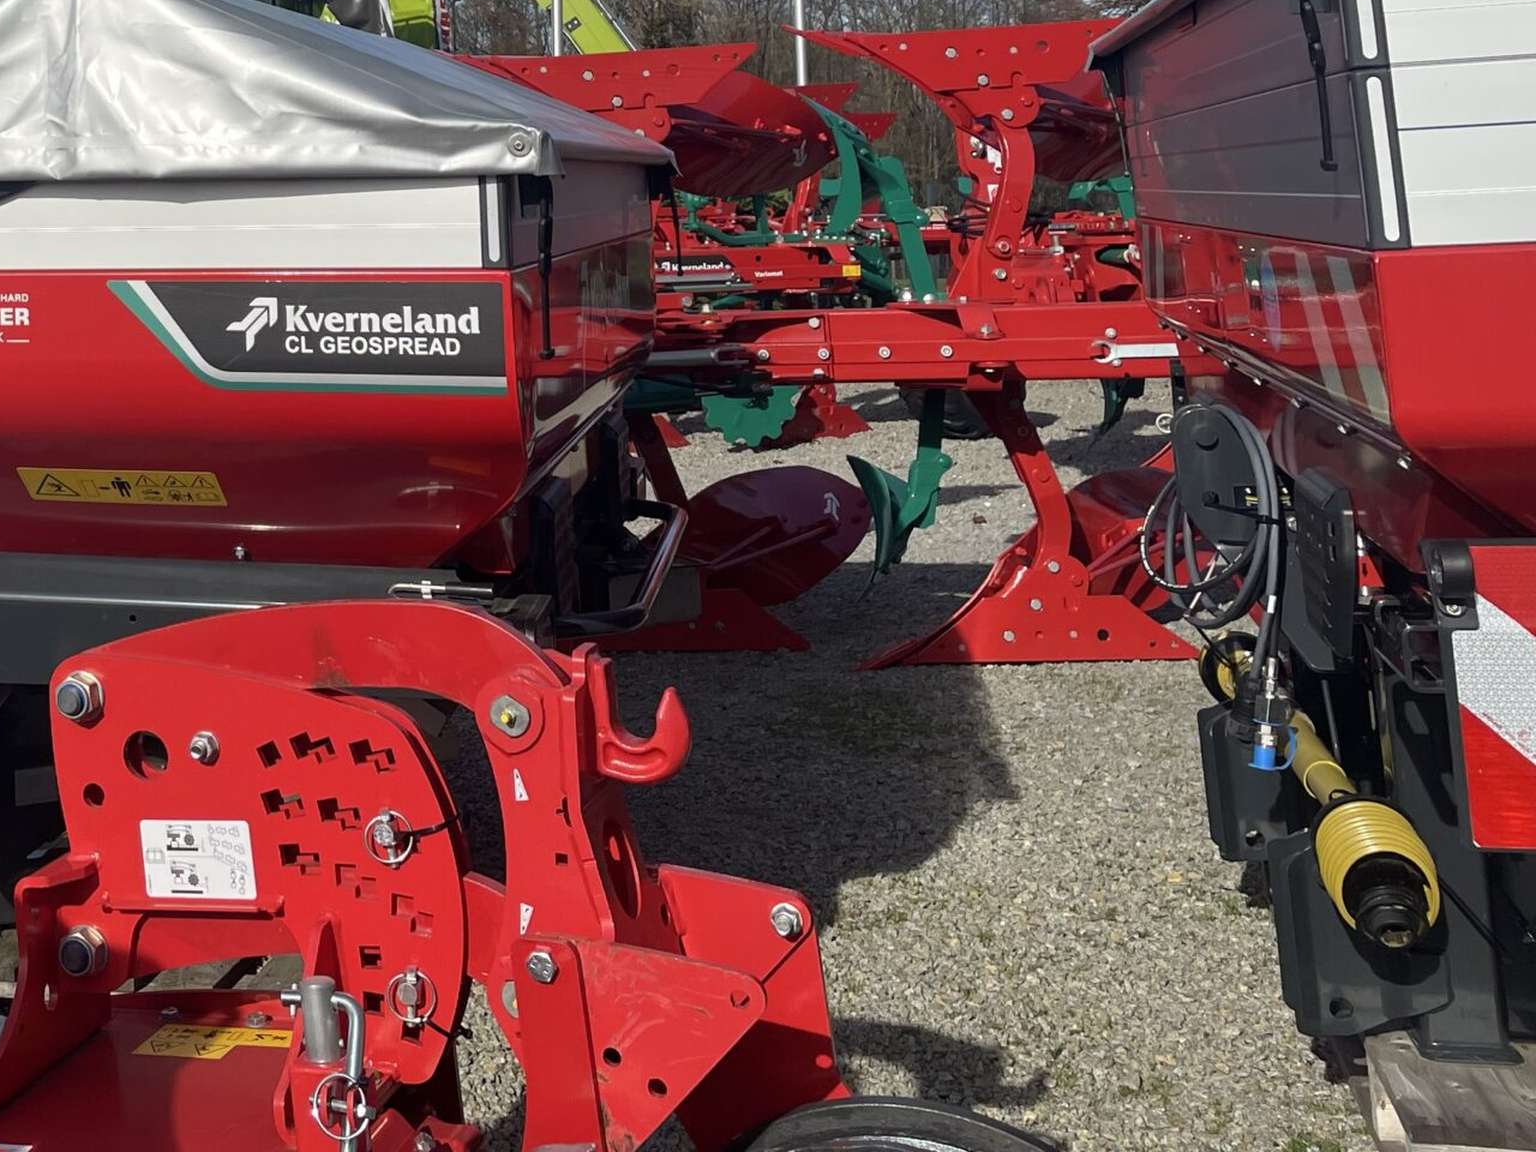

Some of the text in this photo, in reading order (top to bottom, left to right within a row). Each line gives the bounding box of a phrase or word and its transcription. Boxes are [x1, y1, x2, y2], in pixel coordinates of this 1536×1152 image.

[672, 262, 724, 272] Kerneland
[285, 305, 481, 334] Kverneland
[285, 336, 461, 356] CL GEOSPREAD
